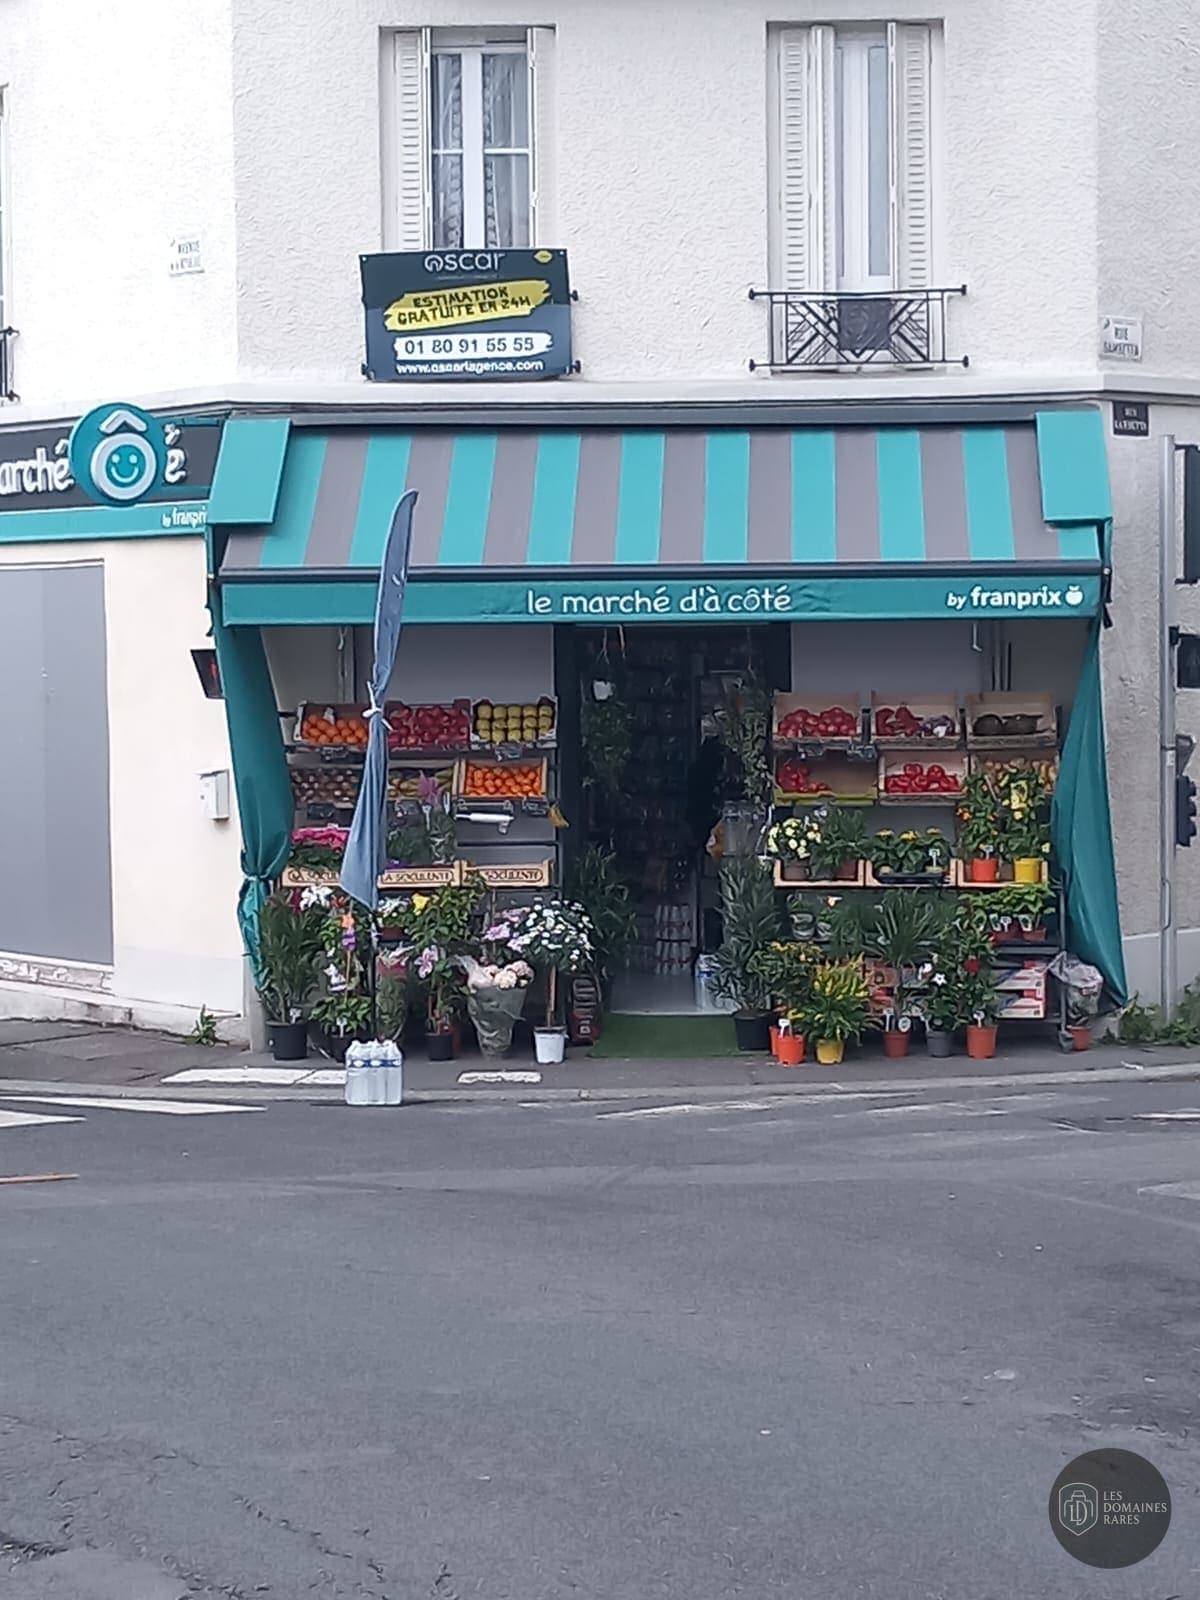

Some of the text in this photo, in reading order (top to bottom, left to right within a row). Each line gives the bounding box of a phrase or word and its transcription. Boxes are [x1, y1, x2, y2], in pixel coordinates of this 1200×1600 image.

[413, 286, 509, 308] ESTIMATION
[397, 296, 531, 326] GRATUITE EN 24H
[404, 336, 535, 355] 01 80 91 55 55
[527, 585, 792, 614] le marché d'à côté
[946, 585, 1062, 610] by franprix
